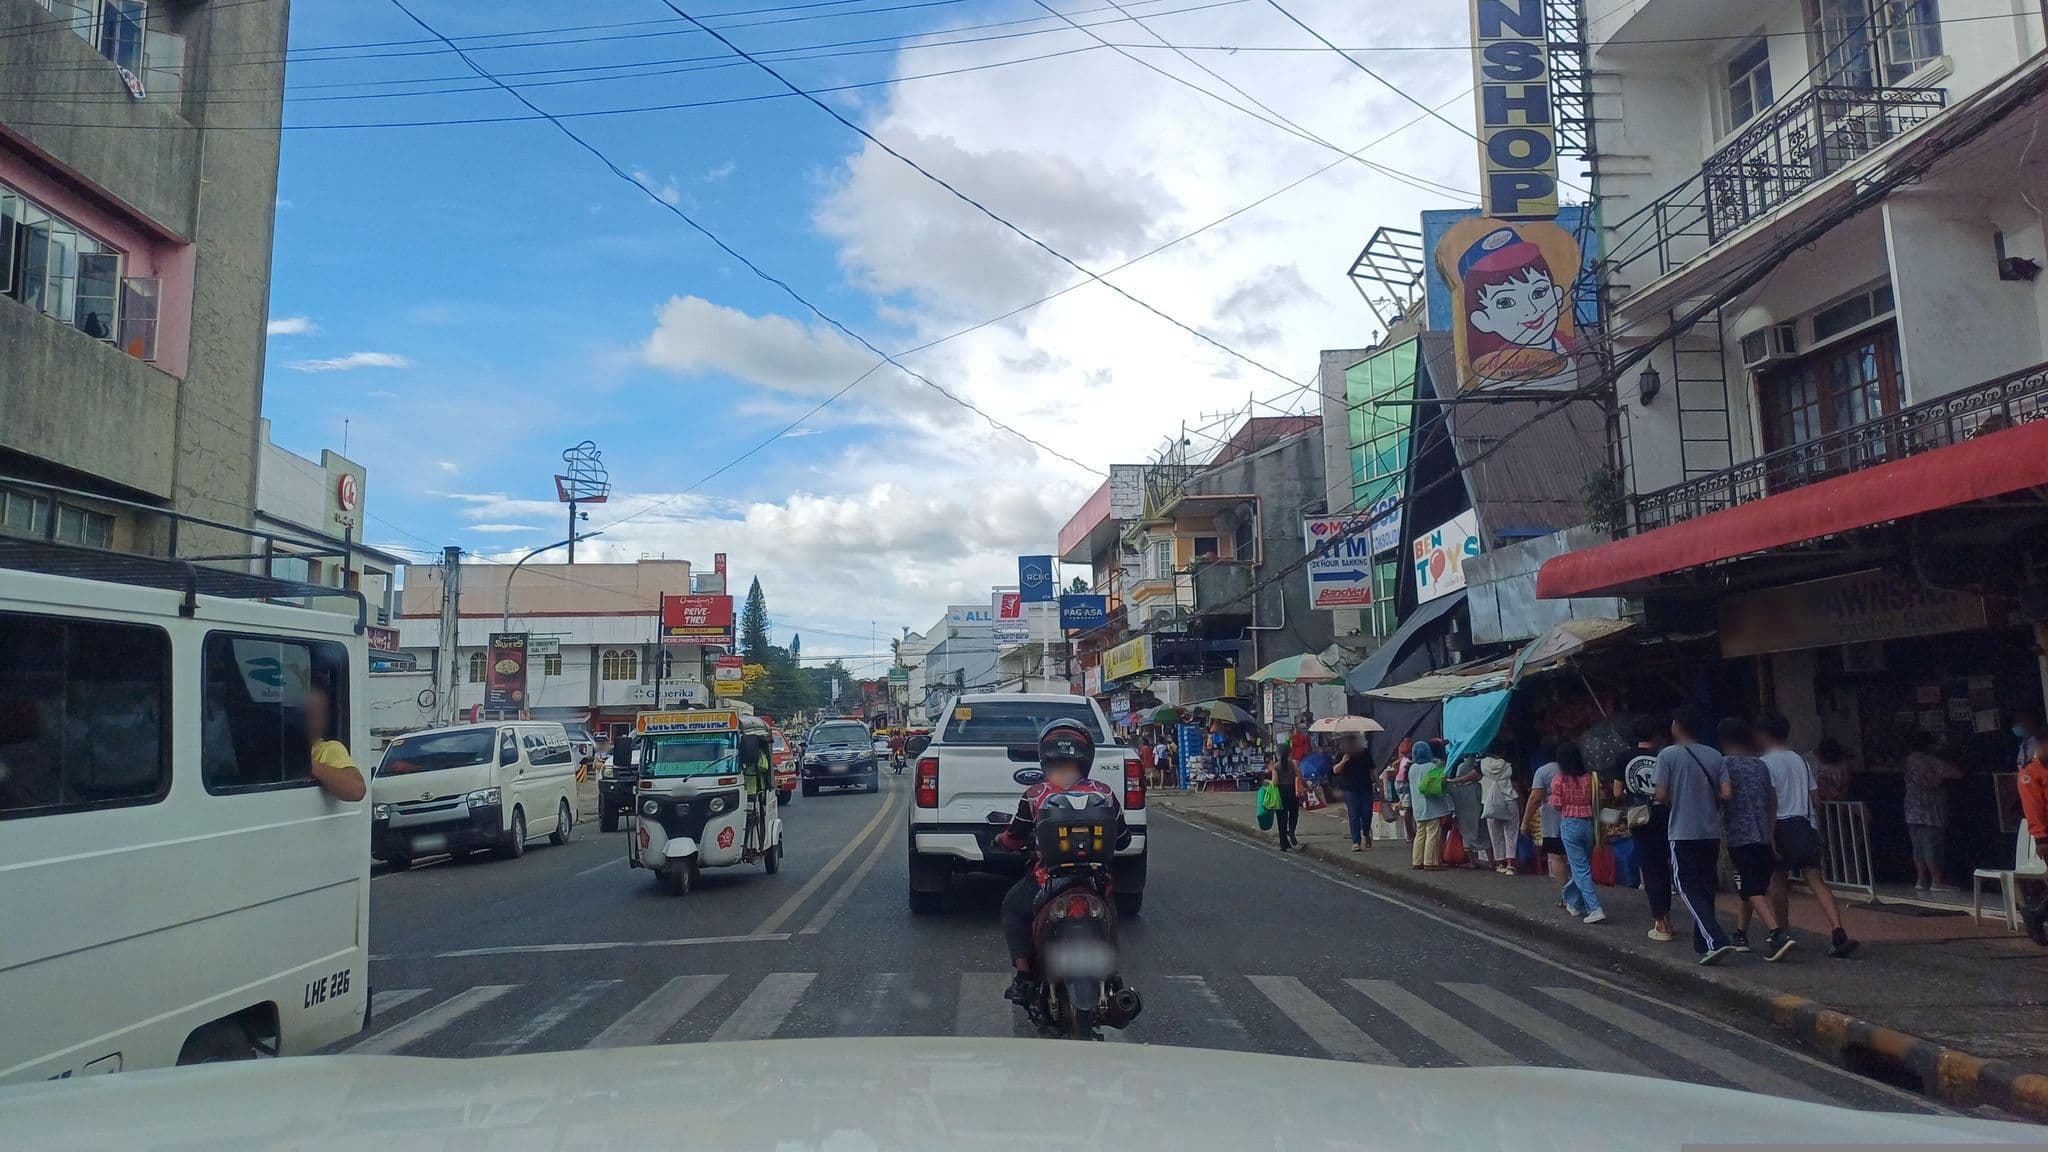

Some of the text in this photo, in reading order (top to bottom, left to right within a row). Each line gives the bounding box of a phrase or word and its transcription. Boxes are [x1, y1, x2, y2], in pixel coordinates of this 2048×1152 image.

[1415, 530, 1442, 560] BEN
[1321, 560, 1340, 568] HOUR
[1342, 558, 1368, 567] BANKING
[1026, 573, 1050, 581] RCBC
[965, 611, 992, 622] ALL
[646, 689, 694, 698] Gerika
[304, 969, 351, 1009] LHE 226
